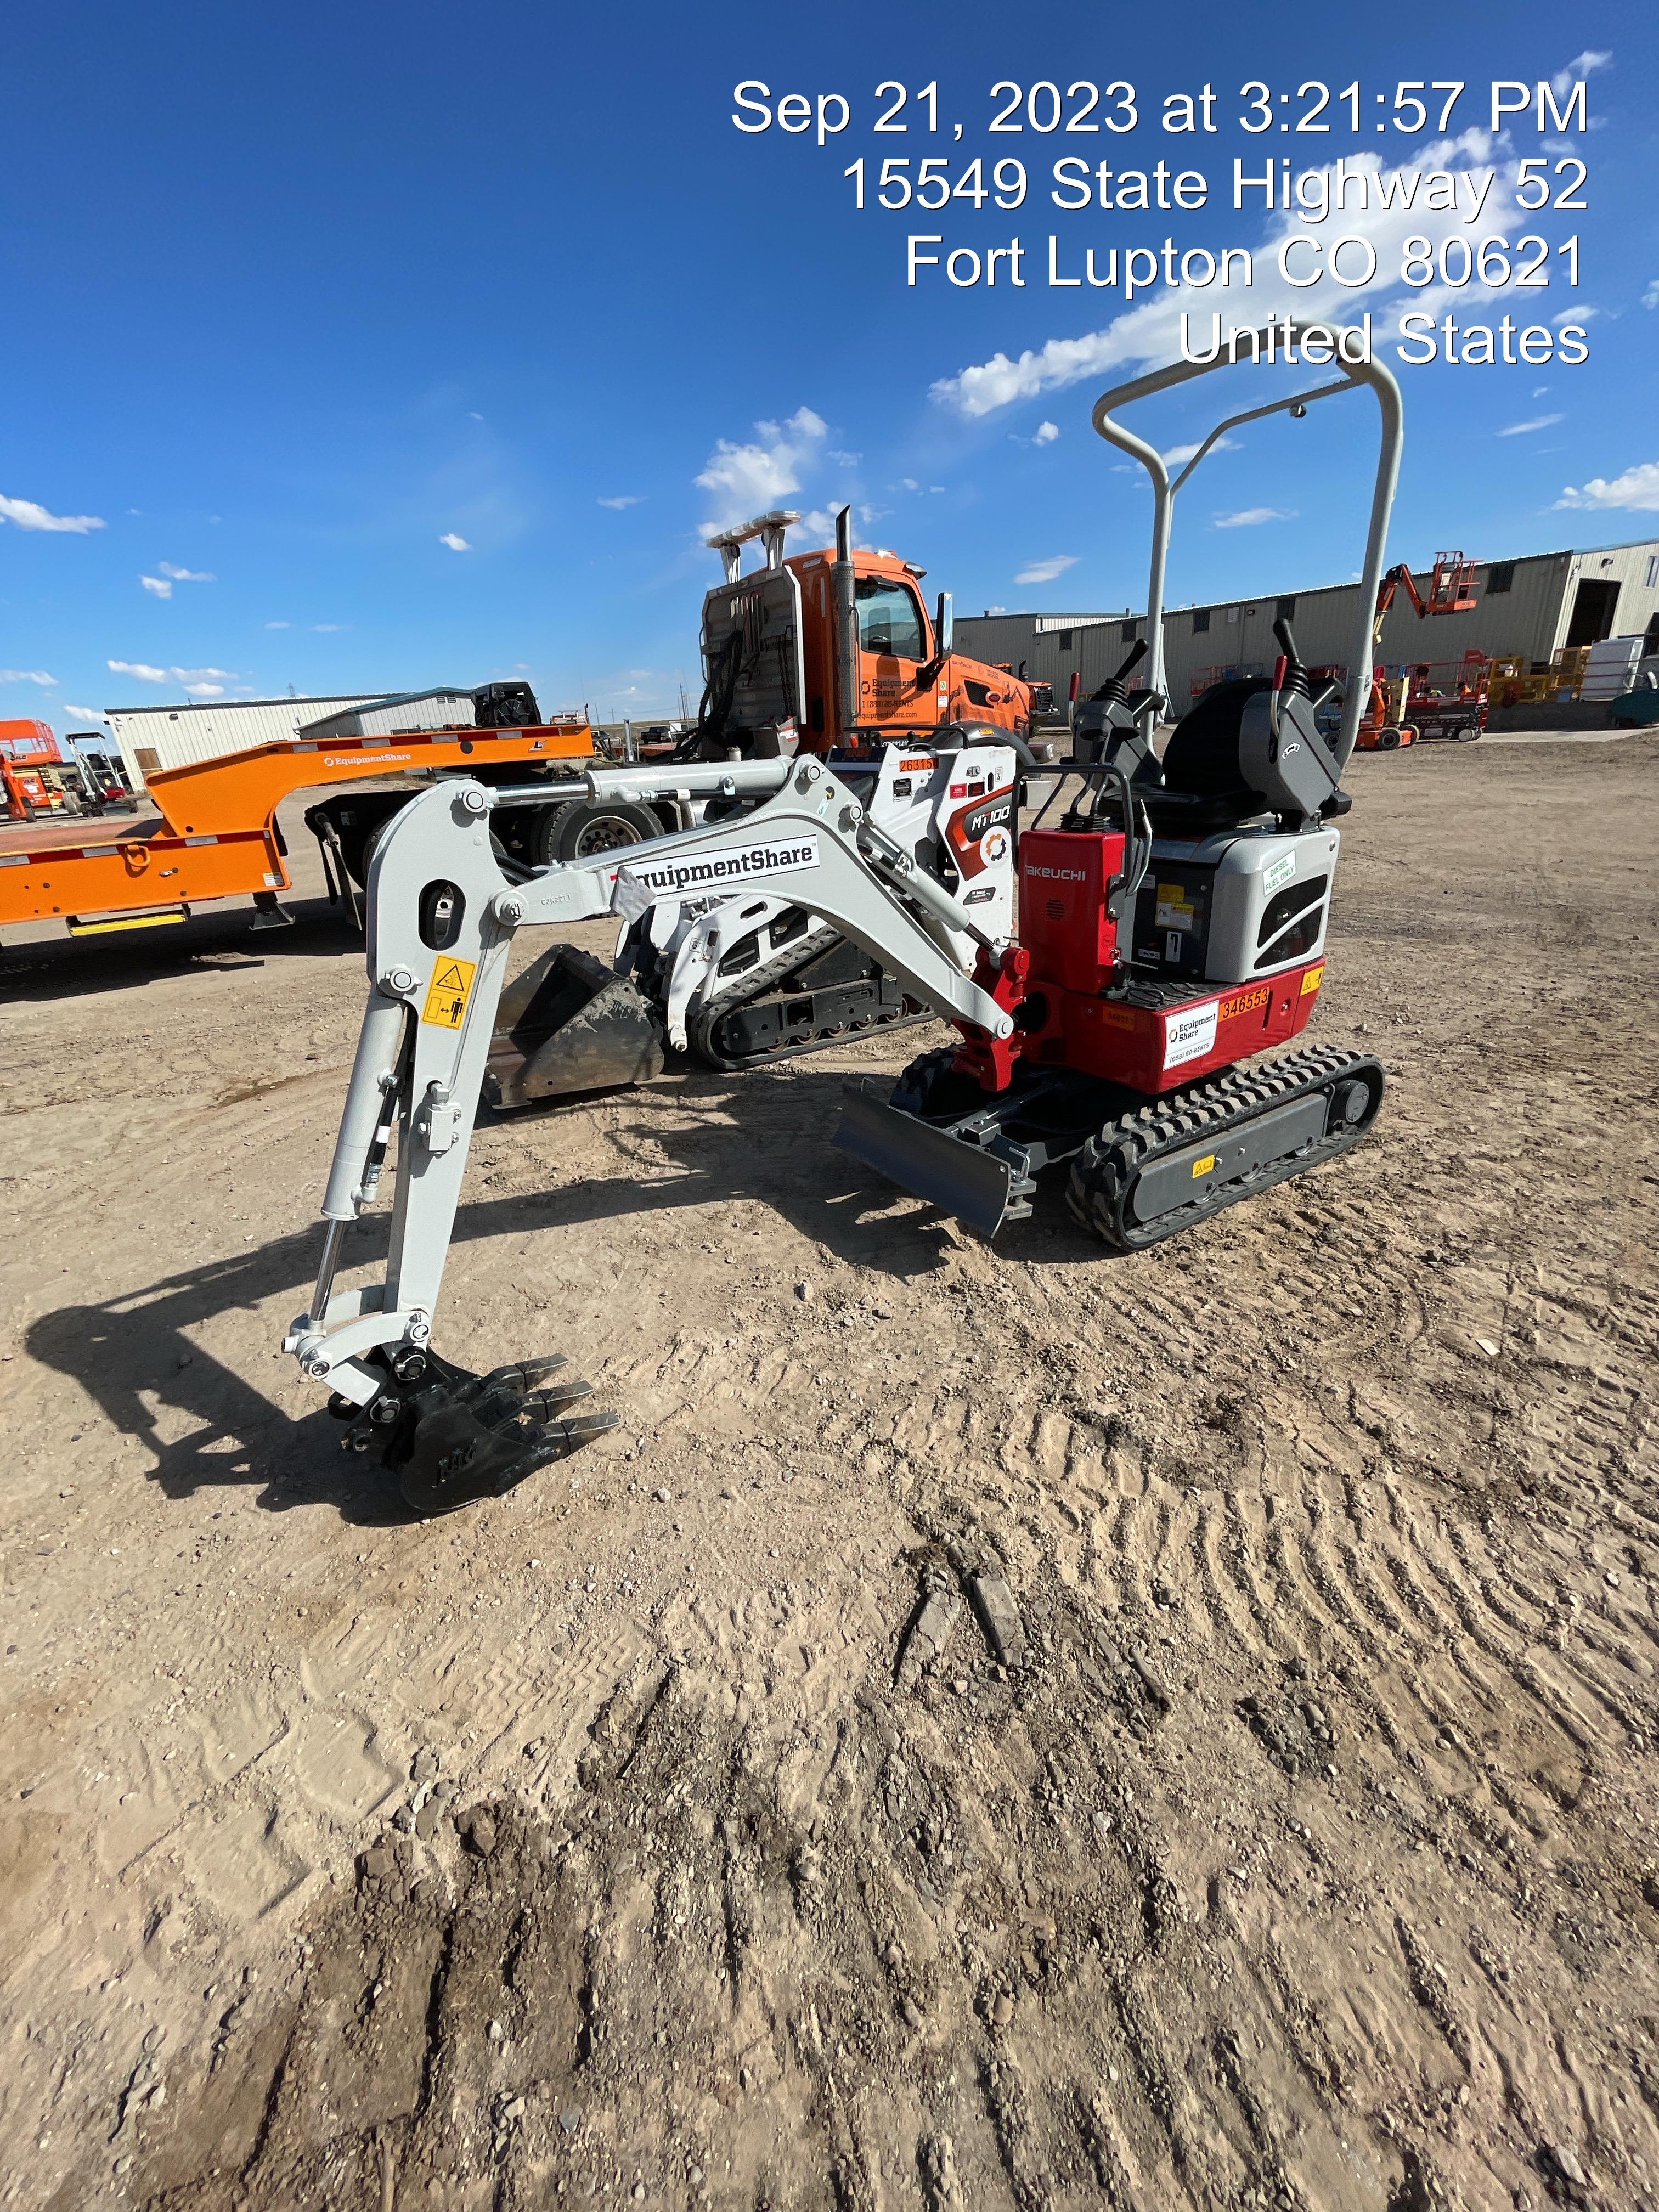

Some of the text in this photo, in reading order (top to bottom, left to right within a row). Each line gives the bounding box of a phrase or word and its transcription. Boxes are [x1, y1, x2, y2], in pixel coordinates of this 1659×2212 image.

[872, 689, 895, 697] Share
[335, 754, 411, 766] EquipmentShare
[972, 805, 1011, 831] MT100
[630, 845, 812, 890] quipmentShare
[1270, 859, 1289, 877] DIESEL
[1266, 865, 1295, 892] FUEL ONLY
[1222, 988, 1268, 1019] 346553
[1179, 1013, 1216, 1032] Equipment
[1179, 1029, 1199, 1042] Share
